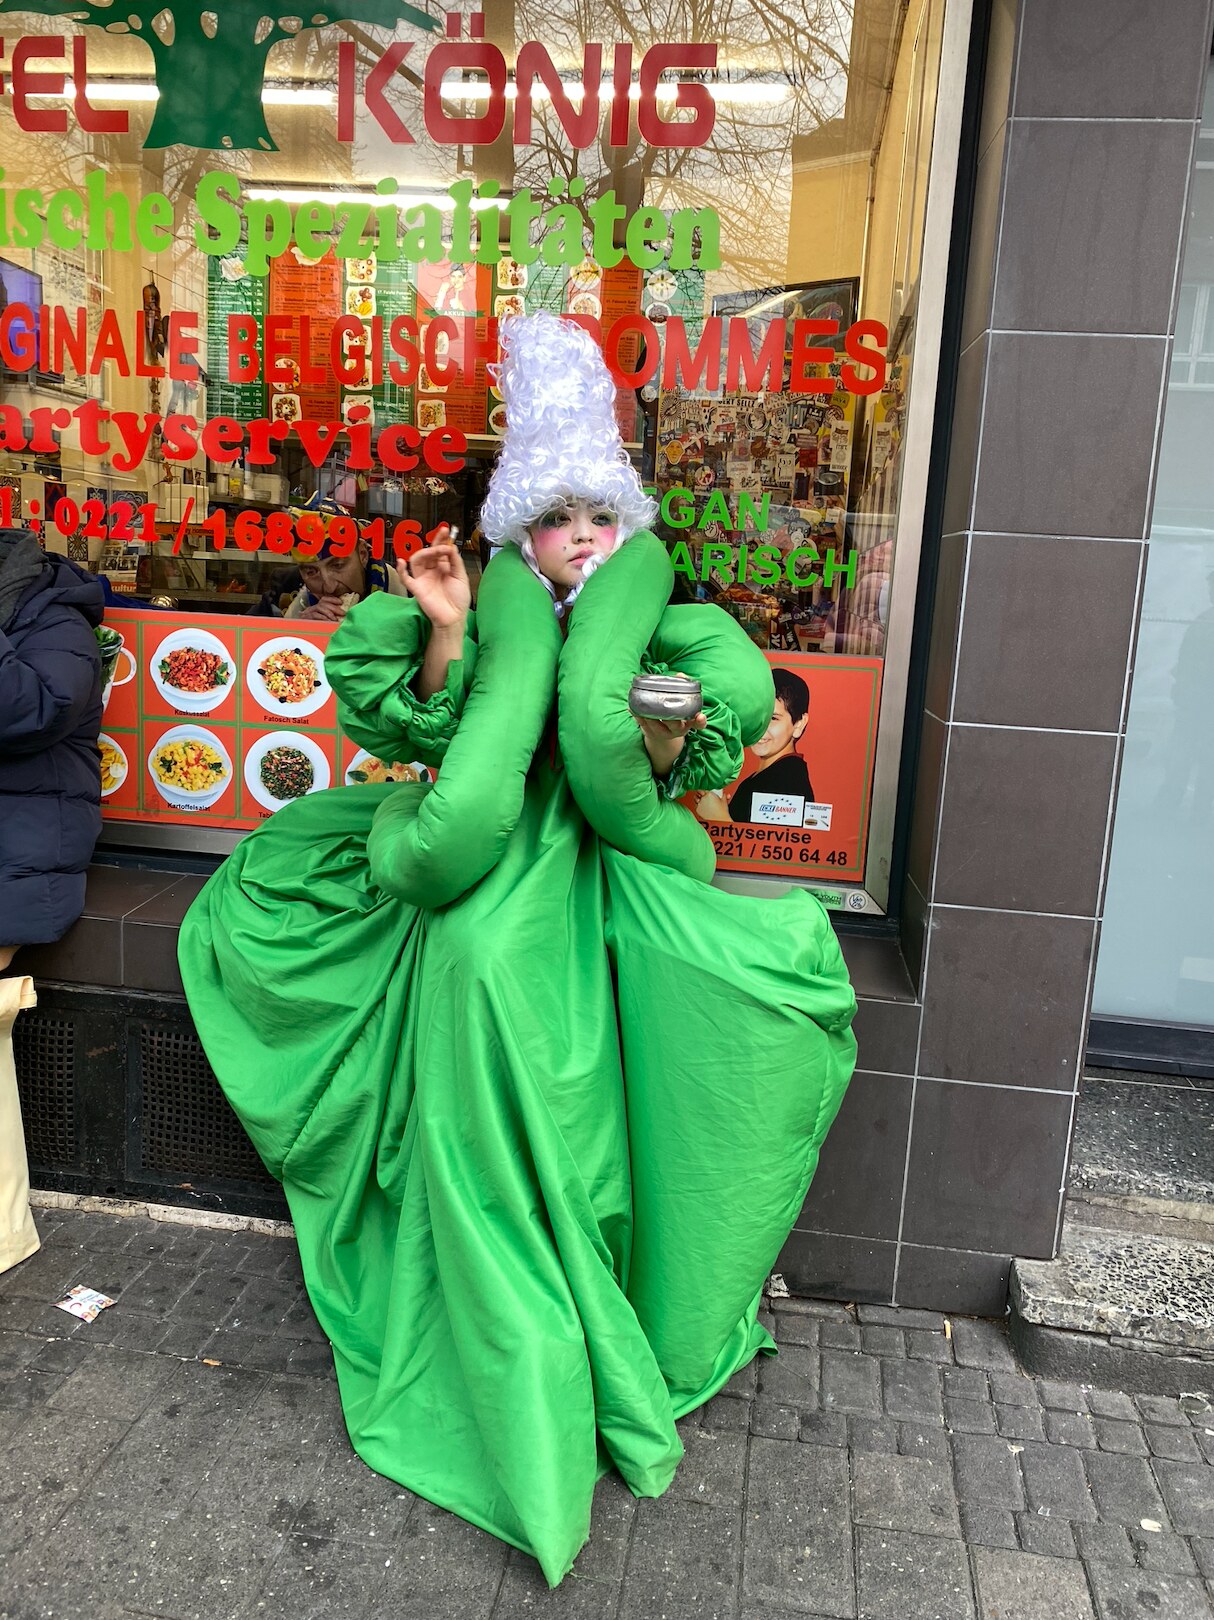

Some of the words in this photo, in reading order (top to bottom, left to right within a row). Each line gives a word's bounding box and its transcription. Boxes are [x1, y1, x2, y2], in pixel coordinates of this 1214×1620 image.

[0, 35, 129, 134] EL
[337, 12, 718, 149] KÖNIG
[195, 170, 722, 277] Spezialitäten
[0, 302, 200, 382] GINALE
[227, 314, 502, 387] BELGISCH
[0, 399, 468, 474] artyservice
[640, 487, 771, 532] GAN
[662, 540, 858, 589] ARISCH
[263, 715, 291, 724] Fatosch
[167, 802, 211, 812] Kartoffelsalat
[749, 843, 757, 858] /
[761, 845, 793, 861] 550
[799, 848, 821, 864] 64
[825, 850, 848, 866] 48
